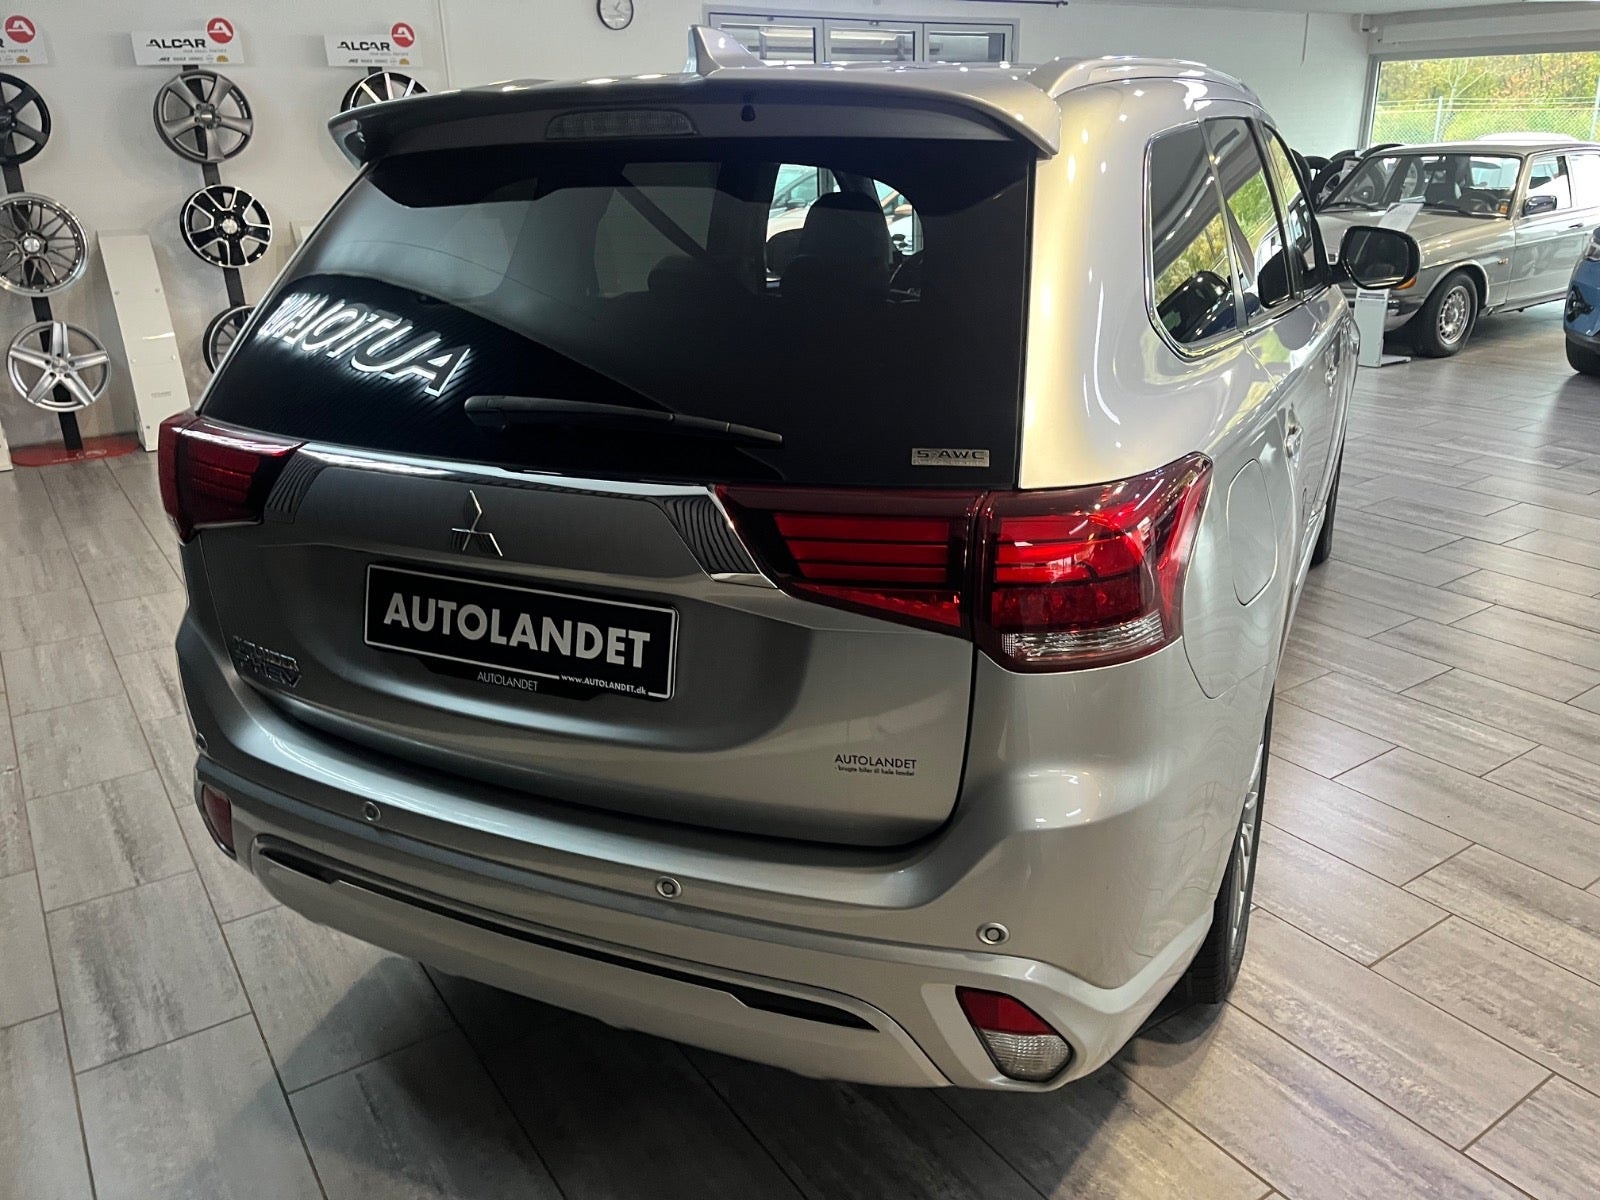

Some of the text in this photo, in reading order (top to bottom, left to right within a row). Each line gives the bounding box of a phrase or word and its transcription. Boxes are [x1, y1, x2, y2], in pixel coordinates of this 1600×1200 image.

[146, 39, 206, 49] ALCAR
[337, 41, 390, 51] ALCAR
[383, 592, 650, 669] AUTOLANDET
[477, 671, 538, 692] AUTOLANDET
[561, 674, 647, 695] www.AUTOLANDET.dk
[835, 754, 917, 769] AUTOLANDET
